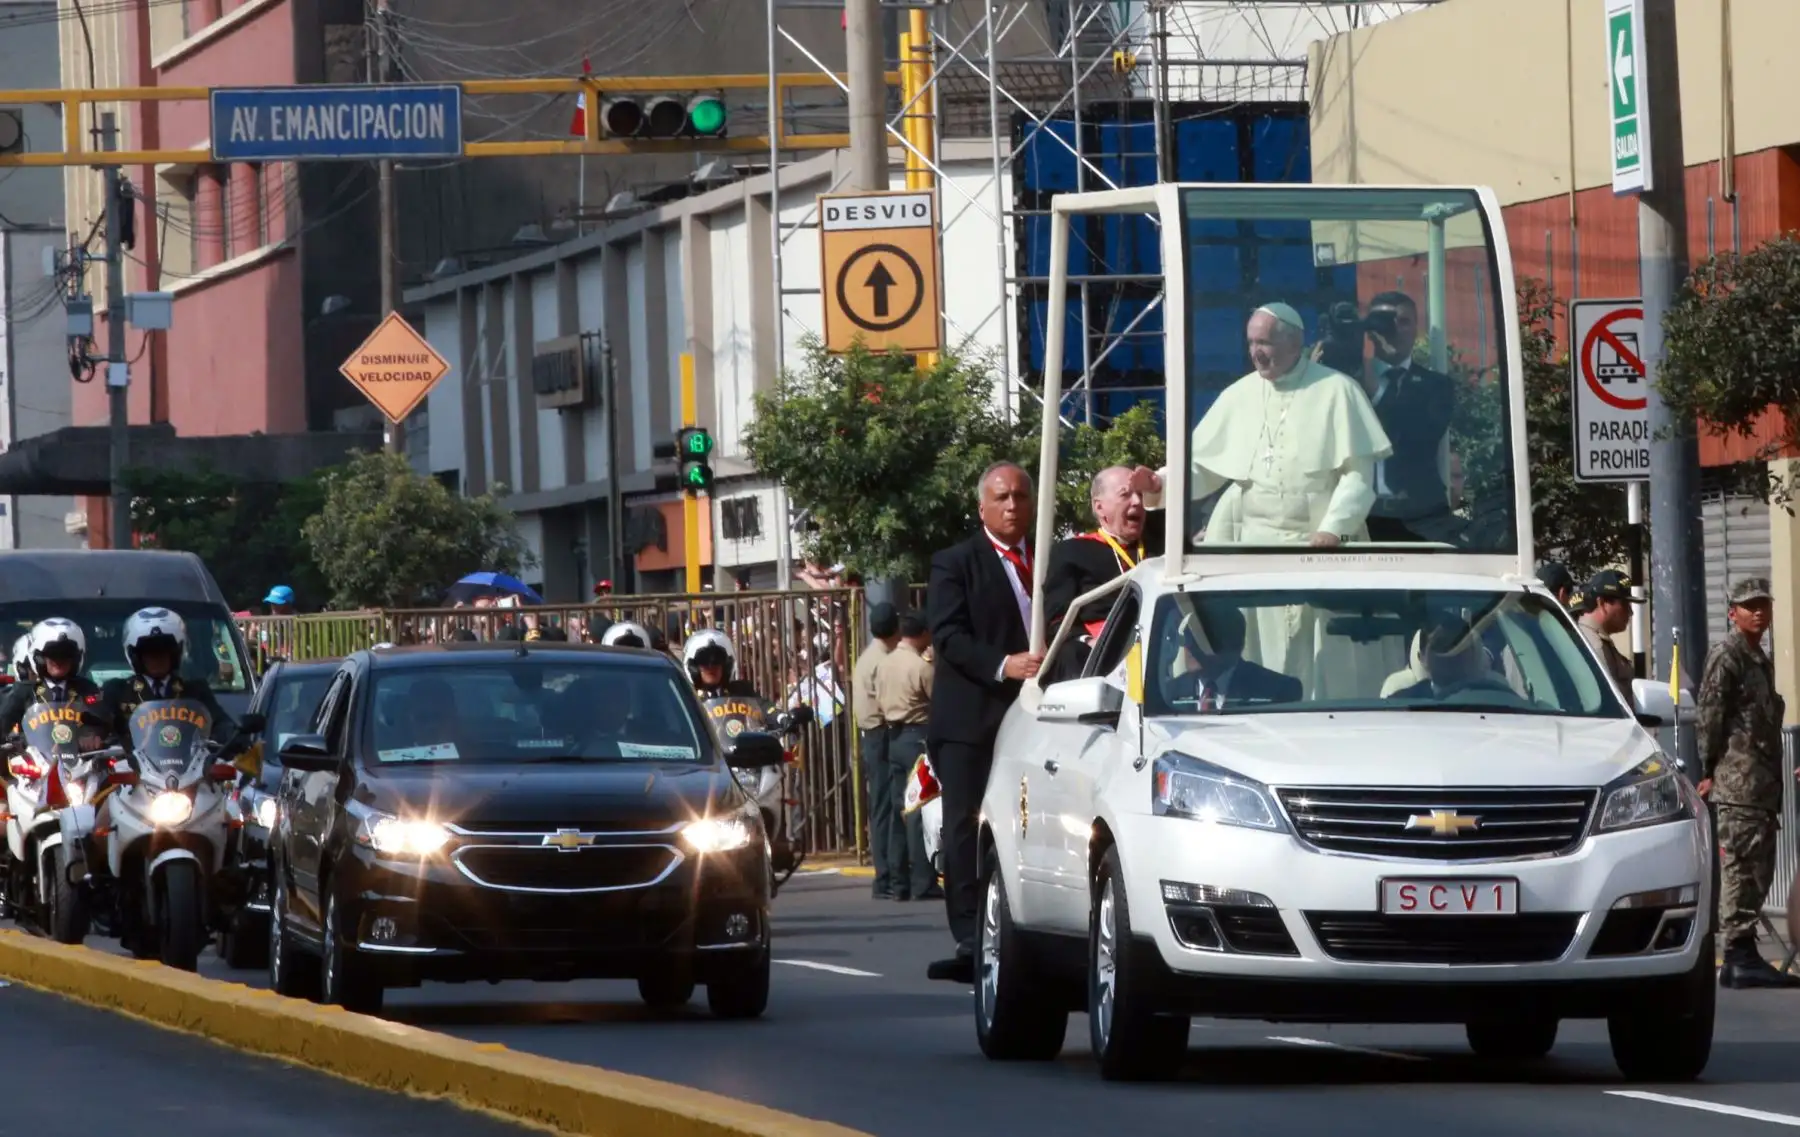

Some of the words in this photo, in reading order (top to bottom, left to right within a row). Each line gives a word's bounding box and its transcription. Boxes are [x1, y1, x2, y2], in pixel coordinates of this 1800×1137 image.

[230, 106, 264, 142] AV.
[271, 102, 444, 141] EMANCIPACION
[1616, 132, 1639, 160] SALIDA
[827, 203, 927, 221] DESVIO
[361, 354, 429, 365] DISMINUIR
[359, 371, 432, 382] VELOCIDAD
